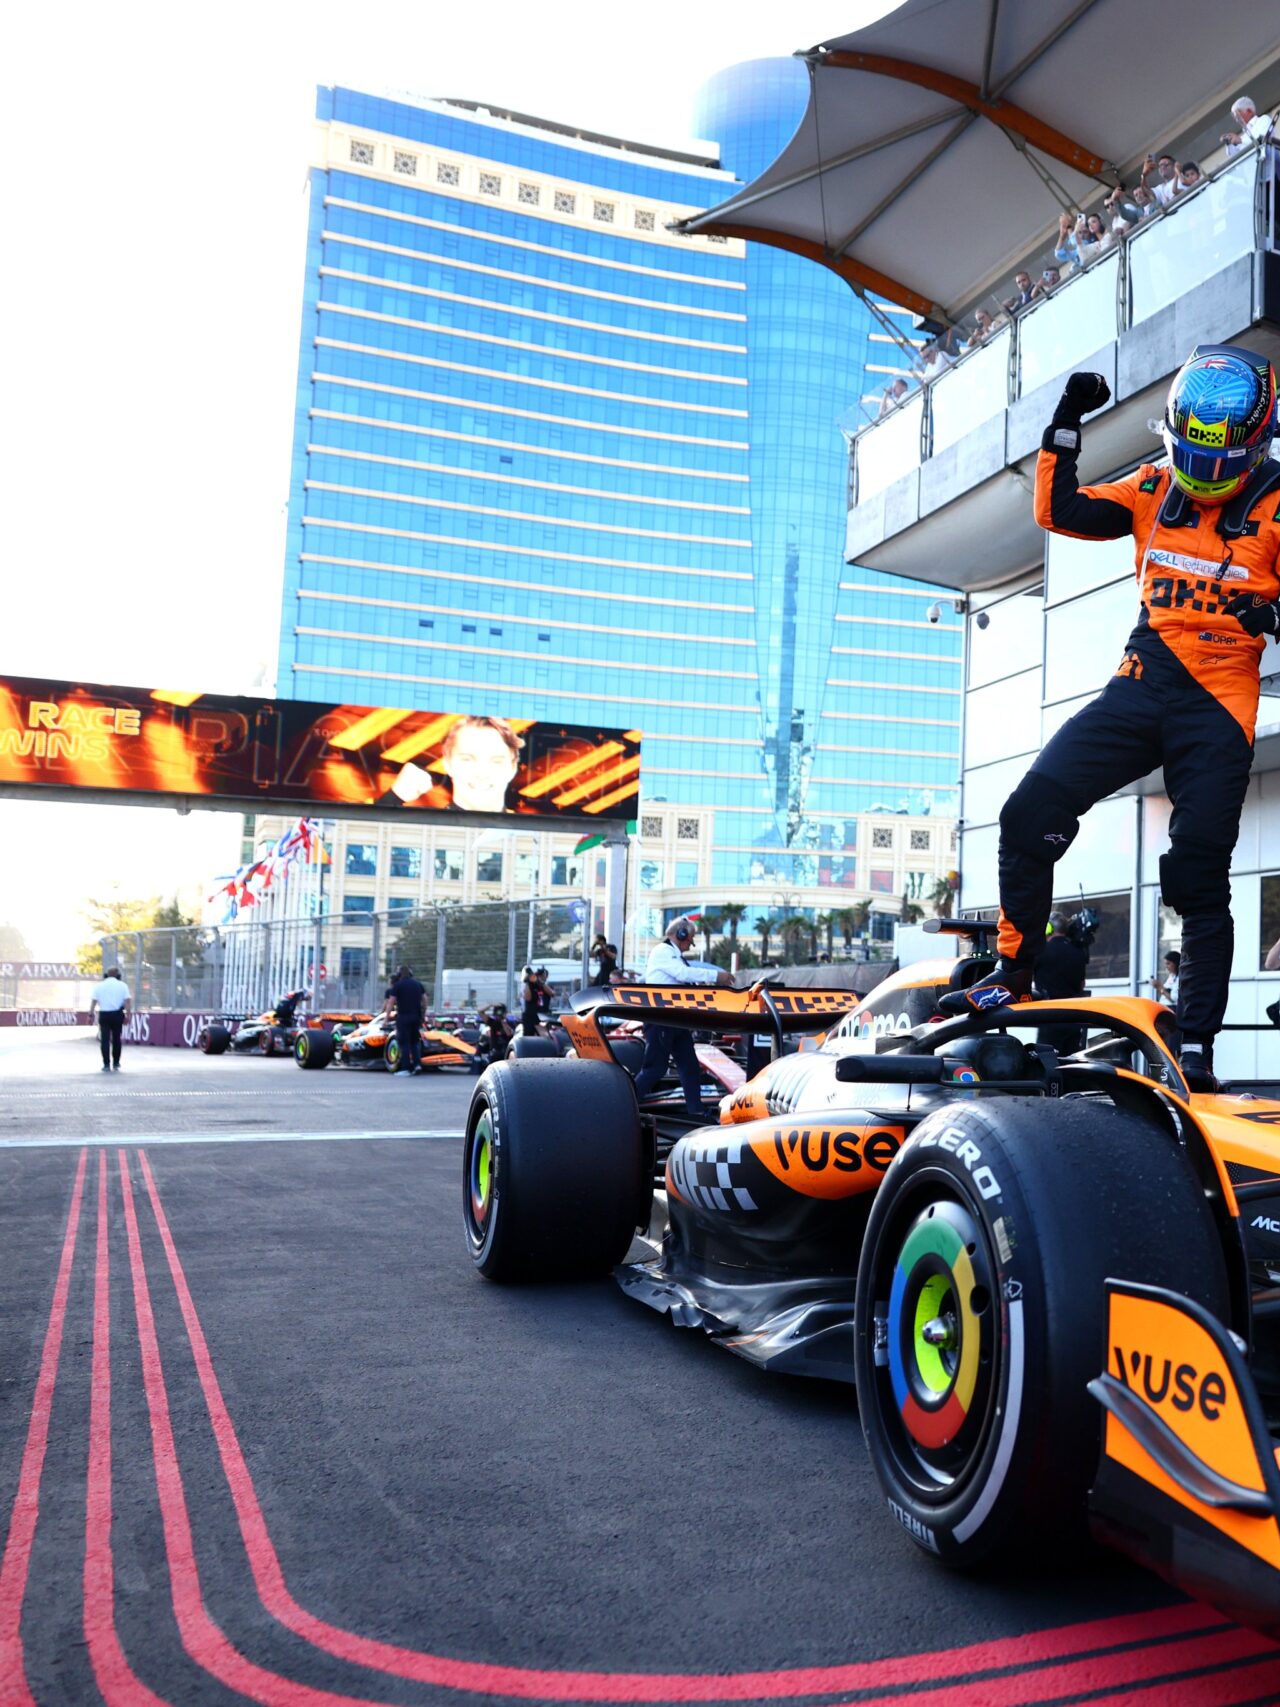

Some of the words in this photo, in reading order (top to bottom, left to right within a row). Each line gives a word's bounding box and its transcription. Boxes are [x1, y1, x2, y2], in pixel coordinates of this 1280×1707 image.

[1189, 427, 1223, 444] OKX
[1181, 557, 1246, 579] Technolgies
[28, 700, 141, 736] RACE
